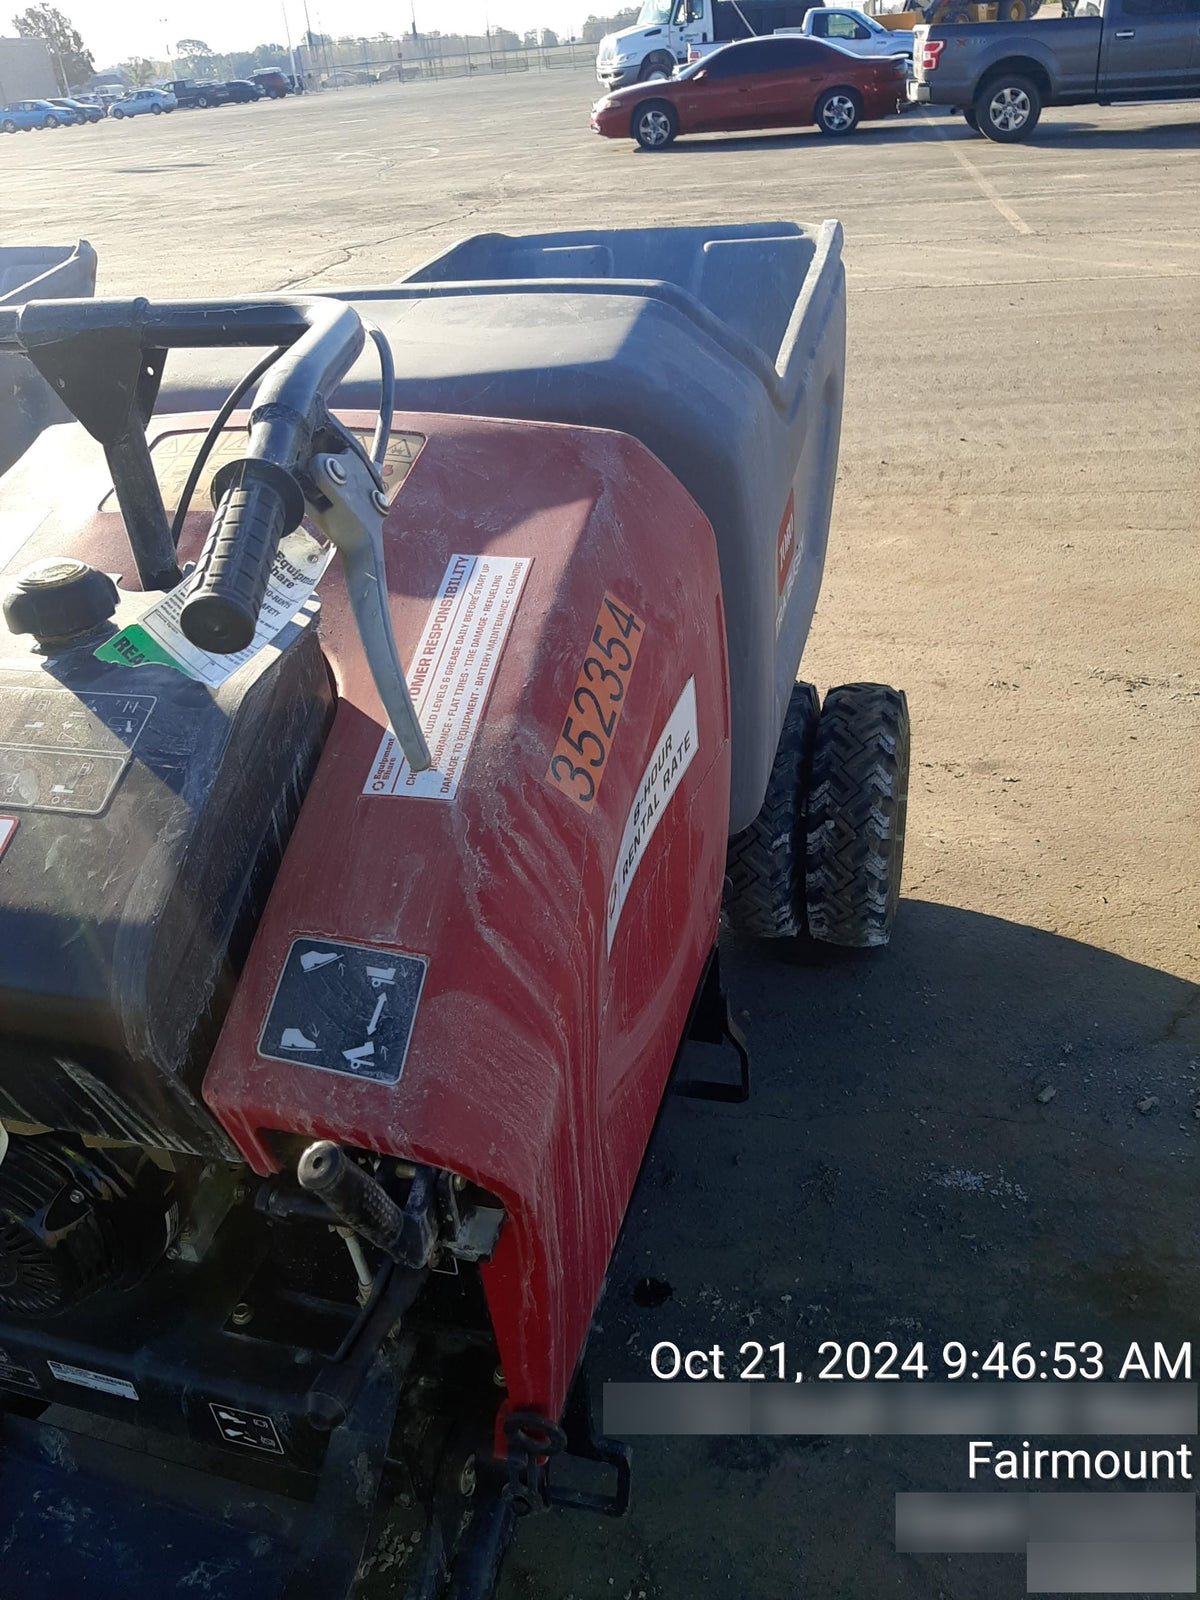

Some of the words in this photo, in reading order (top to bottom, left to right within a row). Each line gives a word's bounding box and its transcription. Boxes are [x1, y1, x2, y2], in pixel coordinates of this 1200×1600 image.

[270, 564, 296, 589] hare
[505, 561, 522, 594] CLEANING
[261, 602, 281, 617] AFETY
[423, 556, 468, 655] RESPONSIBILITY
[486, 599, 509, 650] MAINTENANCE
[113, 636, 149, 665] REA
[423, 714, 437, 737] FLUID
[432, 684, 447, 711] LEVELS
[445, 646, 460, 675] GREASE
[456, 623, 468, 644] DAILY
[463, 595, 478, 622] BEFORE
[473, 574, 486, 594] START
[482, 563, 490, 572] UP
[429, 722, 452, 771] INSURANCE
[448, 697, 460, 715] FLAT
[454, 672, 468, 695] TIRES
[464, 648, 476, 666] TIRE
[471, 617, 487, 647] DAMAGE
[483, 575, 501, 611] REFUELING
[475, 652, 492, 685] BATTERY
[457, 692, 479, 740] EQUIPMENT
[551, 598, 641, 802] 352354
[453, 742, 463, 753] TO
[440, 755, 458, 793] DAMAGE
[633, 733, 673, 826] 8-HOUR
[622, 793, 660, 884] RENTAL
[663, 730, 691, 792] RATE
